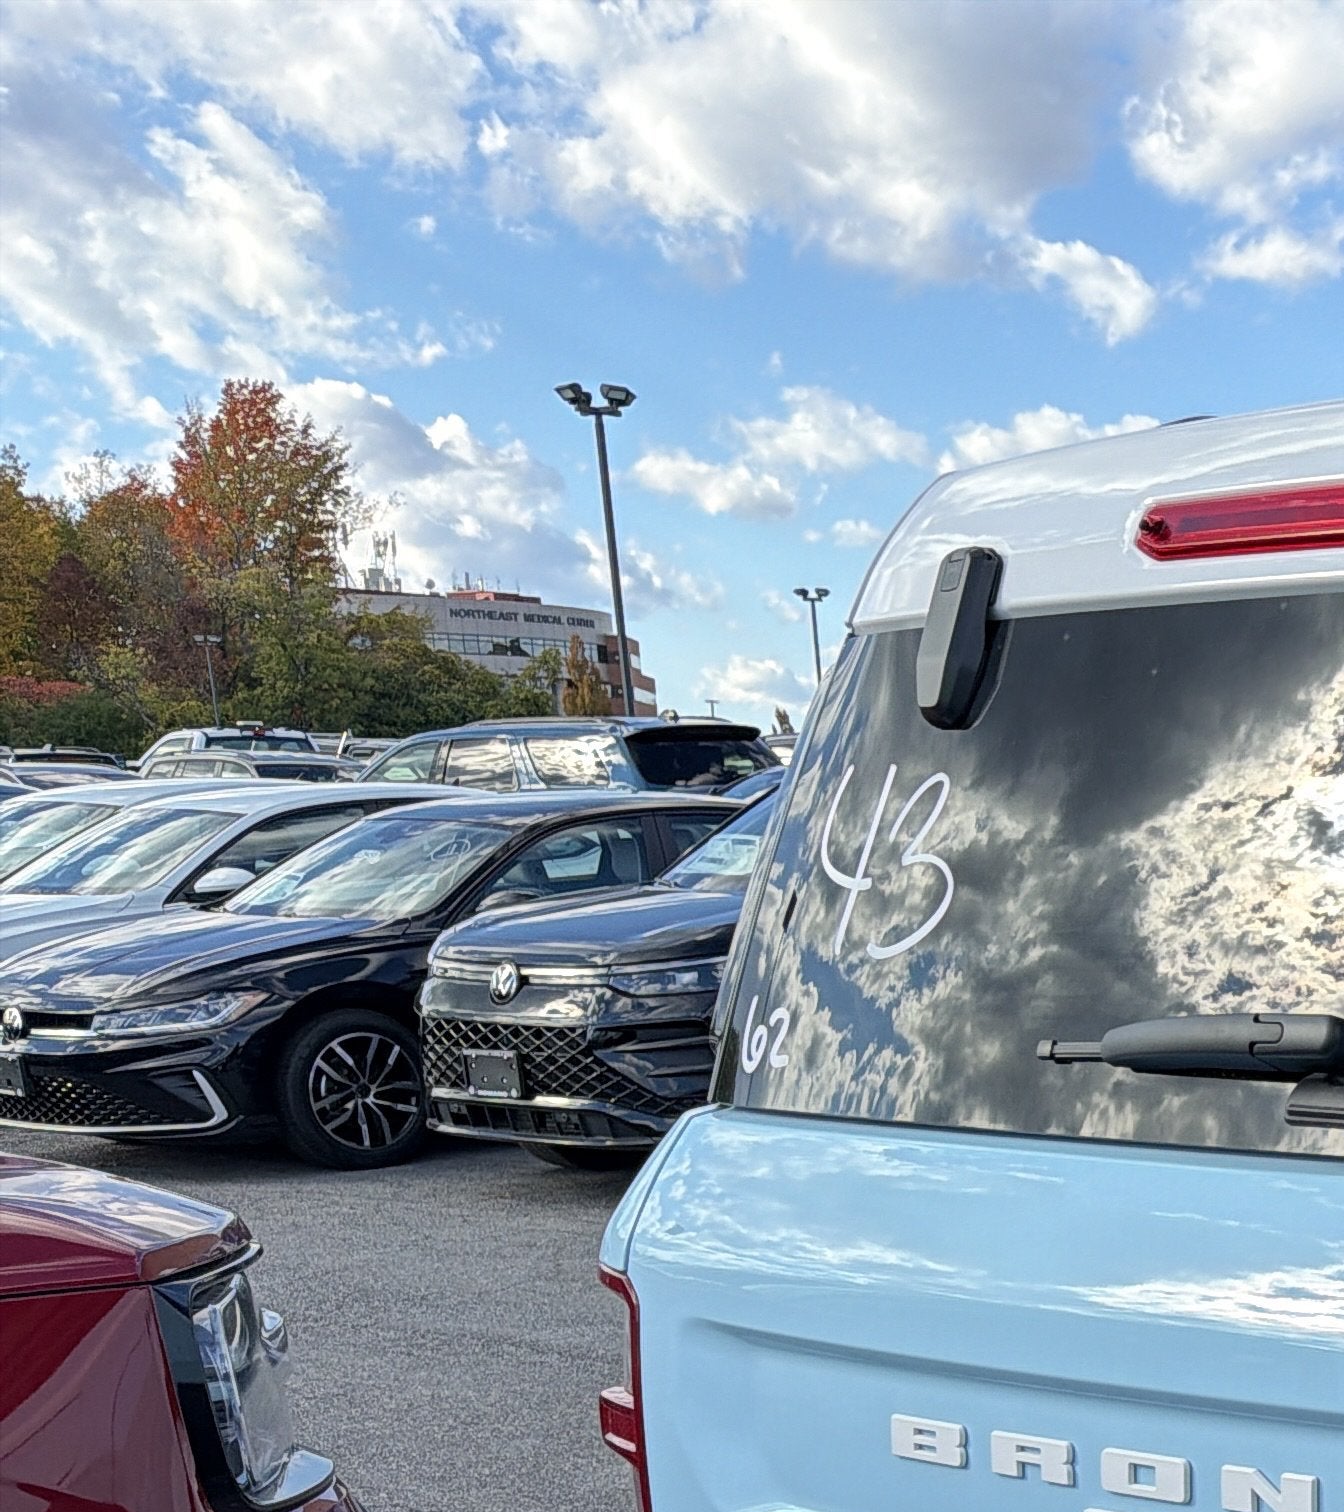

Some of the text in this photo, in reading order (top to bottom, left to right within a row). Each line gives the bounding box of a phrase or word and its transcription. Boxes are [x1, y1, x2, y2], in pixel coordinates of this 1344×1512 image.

[449, 608, 596, 629] NORTHEAST MEDICAL CENTER
[821, 764, 954, 960] 43
[741, 995, 790, 1074] 62
